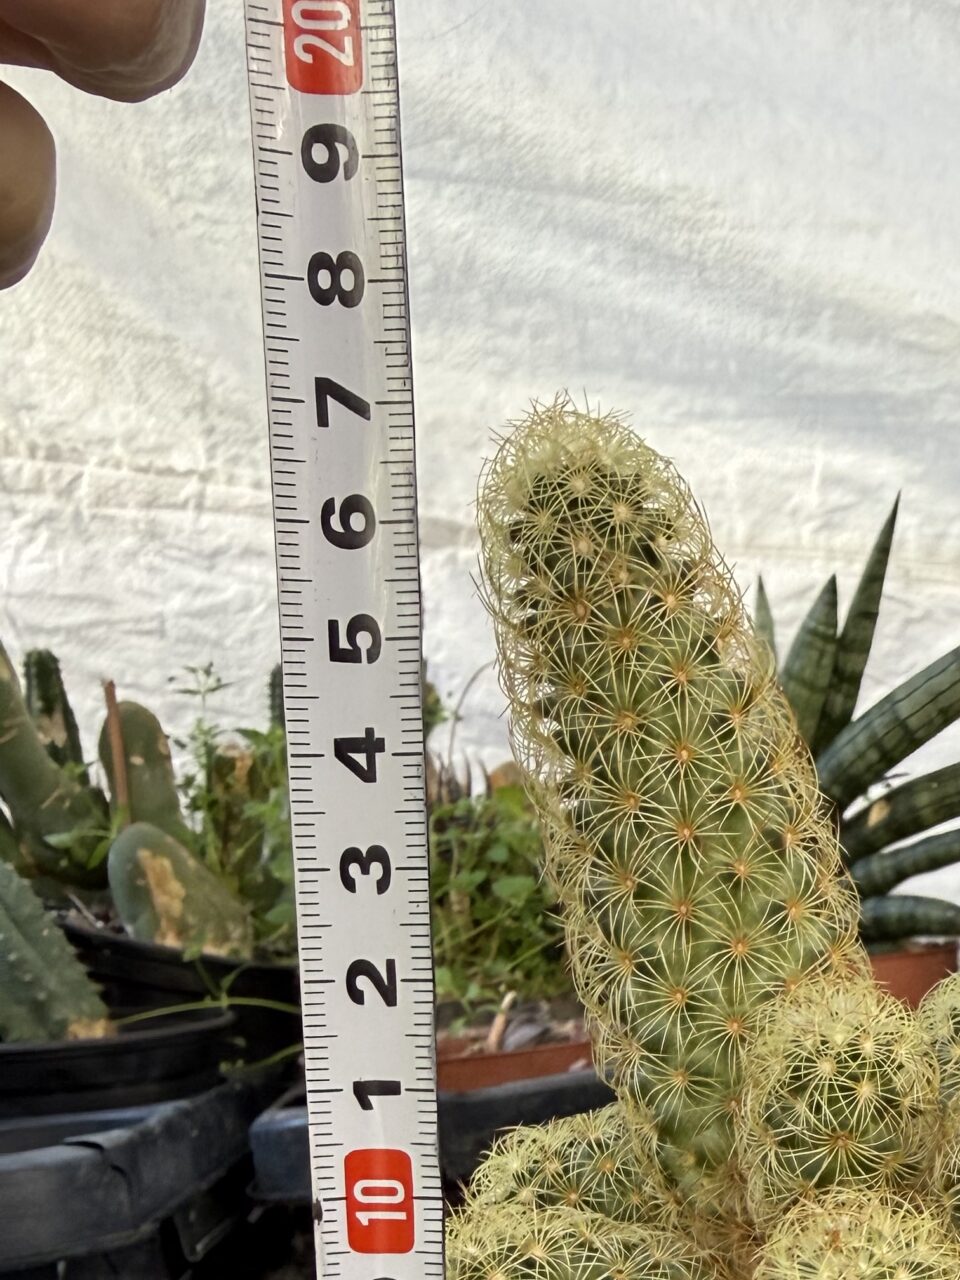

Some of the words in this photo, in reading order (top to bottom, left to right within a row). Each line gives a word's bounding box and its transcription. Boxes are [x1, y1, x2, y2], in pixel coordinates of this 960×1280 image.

[291, 1, 354, 67] 20
[300, 123, 359, 183] 9
[307, 250, 365, 309] 8
[314, 376, 371, 428] 7
[320, 493, 376, 550] 6
[327, 612, 382, 665] 5
[333, 726, 386, 783] 4
[339, 843, 392, 895] 3
[345, 957, 398, 1008] 2
[352, 1078, 402, 1112] 1
[354, 1178, 407, 1226] 10
